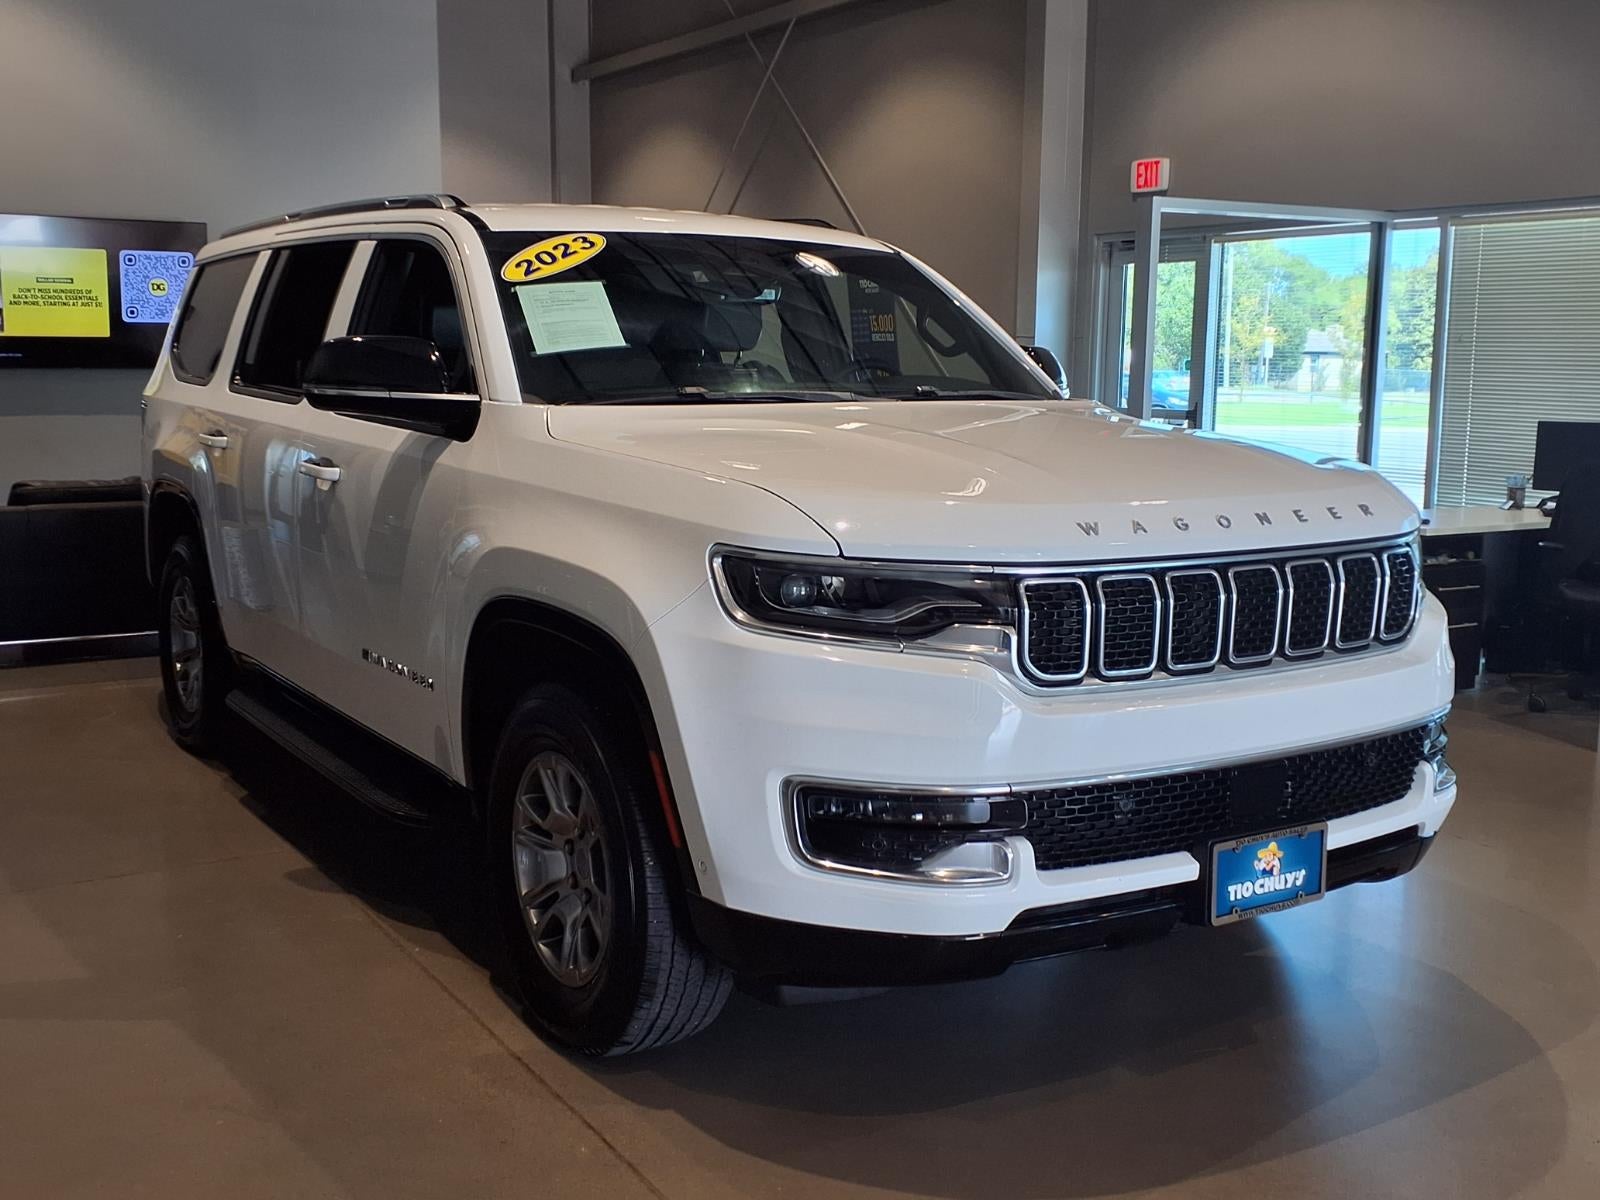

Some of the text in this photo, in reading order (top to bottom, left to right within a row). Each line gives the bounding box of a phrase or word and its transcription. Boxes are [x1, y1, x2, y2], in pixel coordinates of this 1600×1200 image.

[1136, 160, 1160, 189] EXIT
[515, 235, 596, 277] 2023
[151, 281, 166, 291] DG
[1076, 503, 1374, 537] WAGONEER
[1228, 868, 1306, 902] TIO CHUY'S
